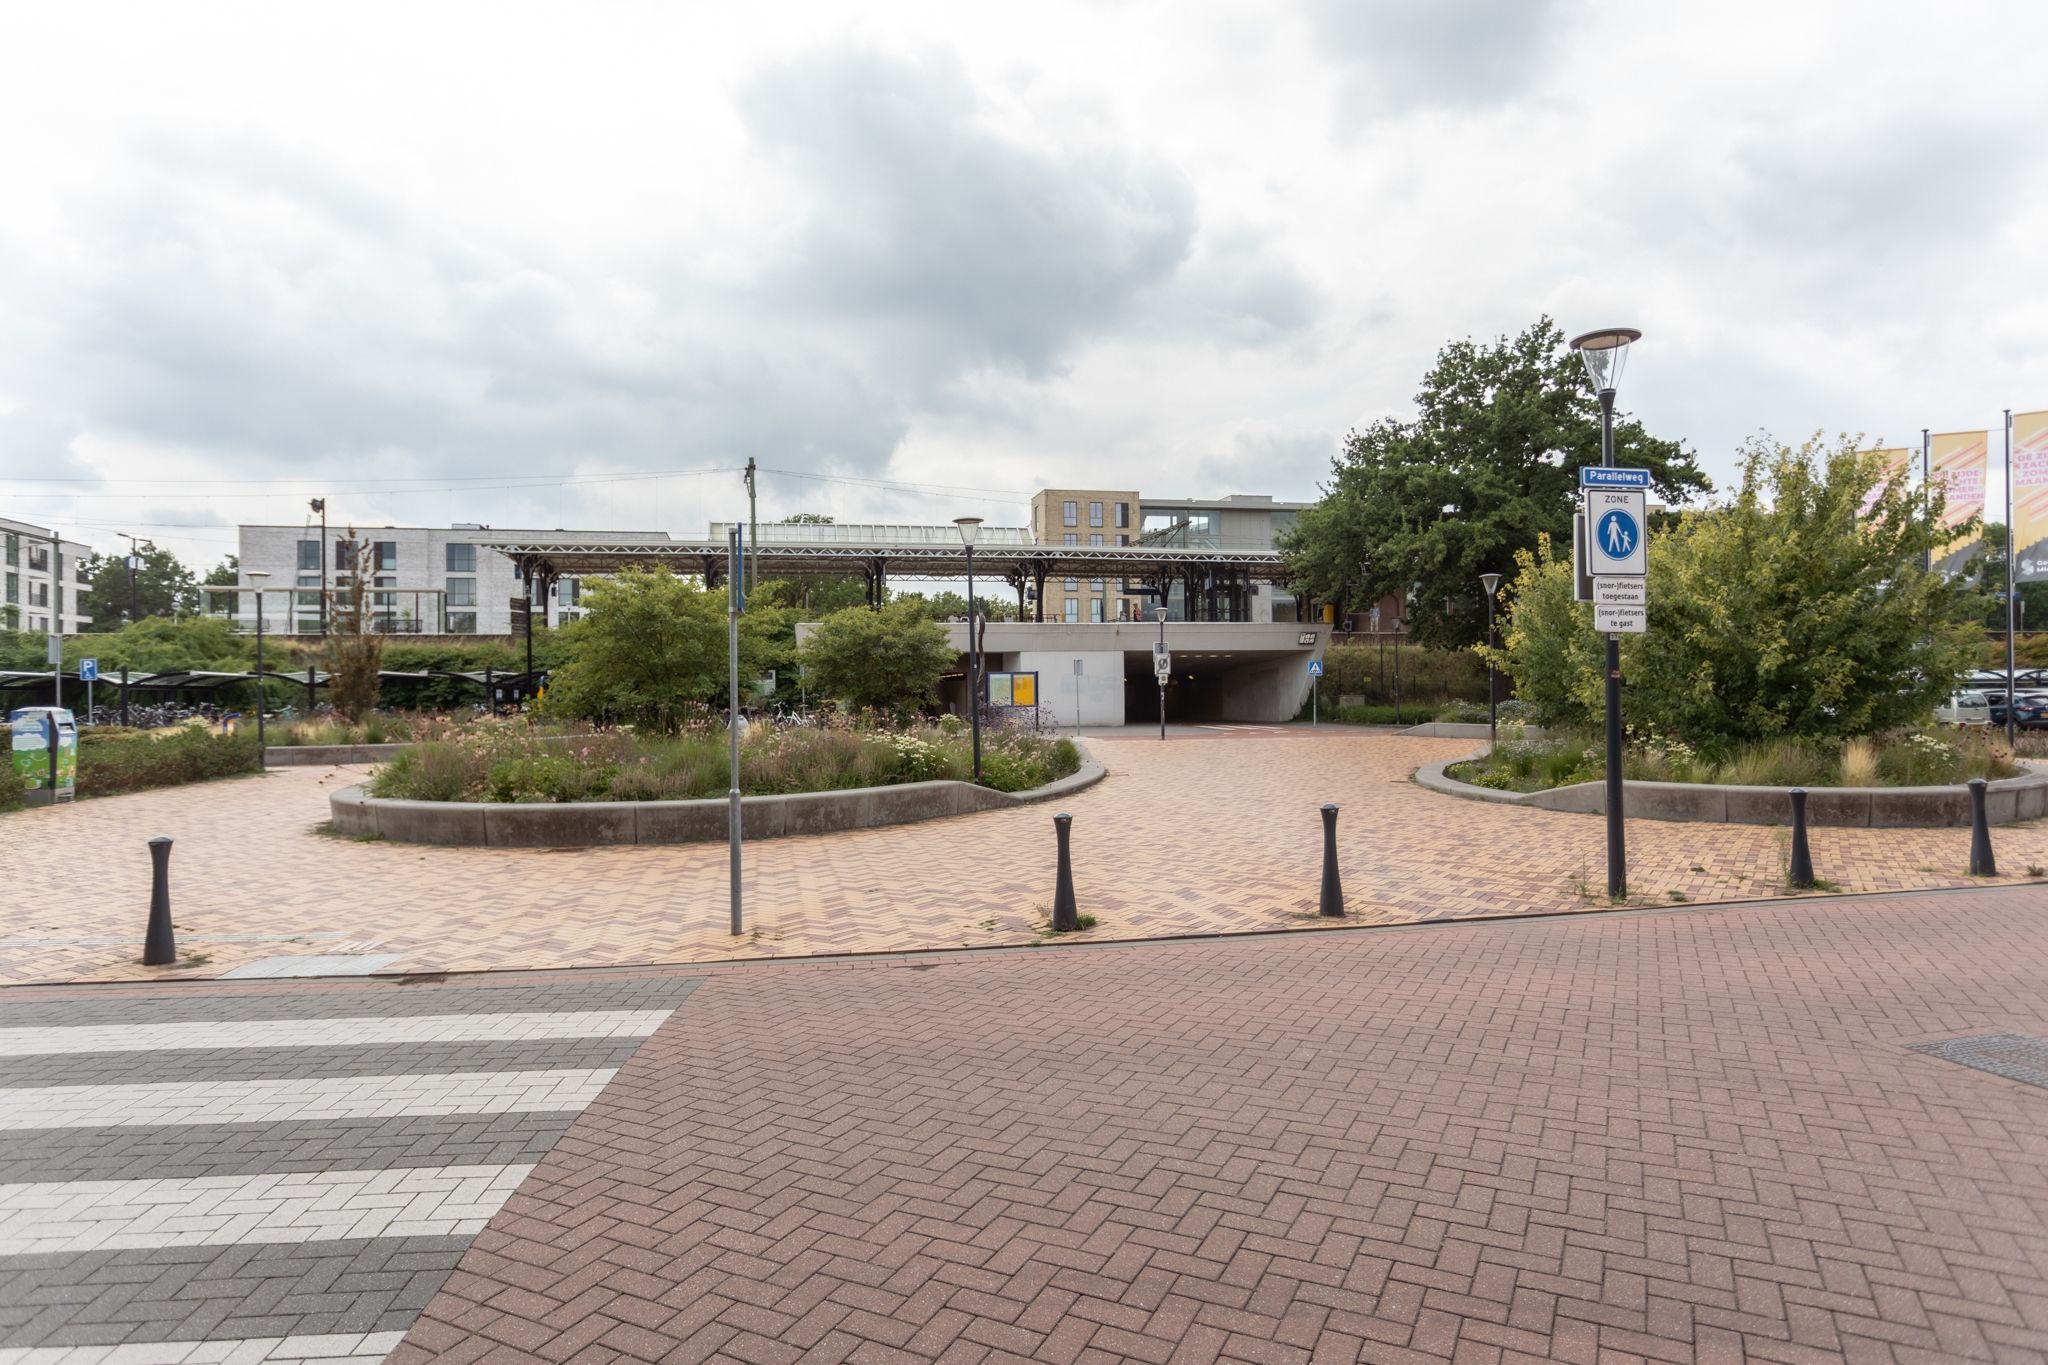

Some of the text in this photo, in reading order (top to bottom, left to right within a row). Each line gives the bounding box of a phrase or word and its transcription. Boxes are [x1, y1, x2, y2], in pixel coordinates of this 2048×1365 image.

[2022, 461, 2048, 470] ZAC
[1589, 470, 1644, 484] Parallelweg
[1604, 495, 1629, 504] ZONE
[1597, 582, 1644, 590] (snor-)fietsers
[1602, 592, 1639, 601] toegestaan
[1598, 609, 1644, 617] (snor-)fietsers
[1619, 620, 1633, 628] gast
[83, 661, 93, 672] P
